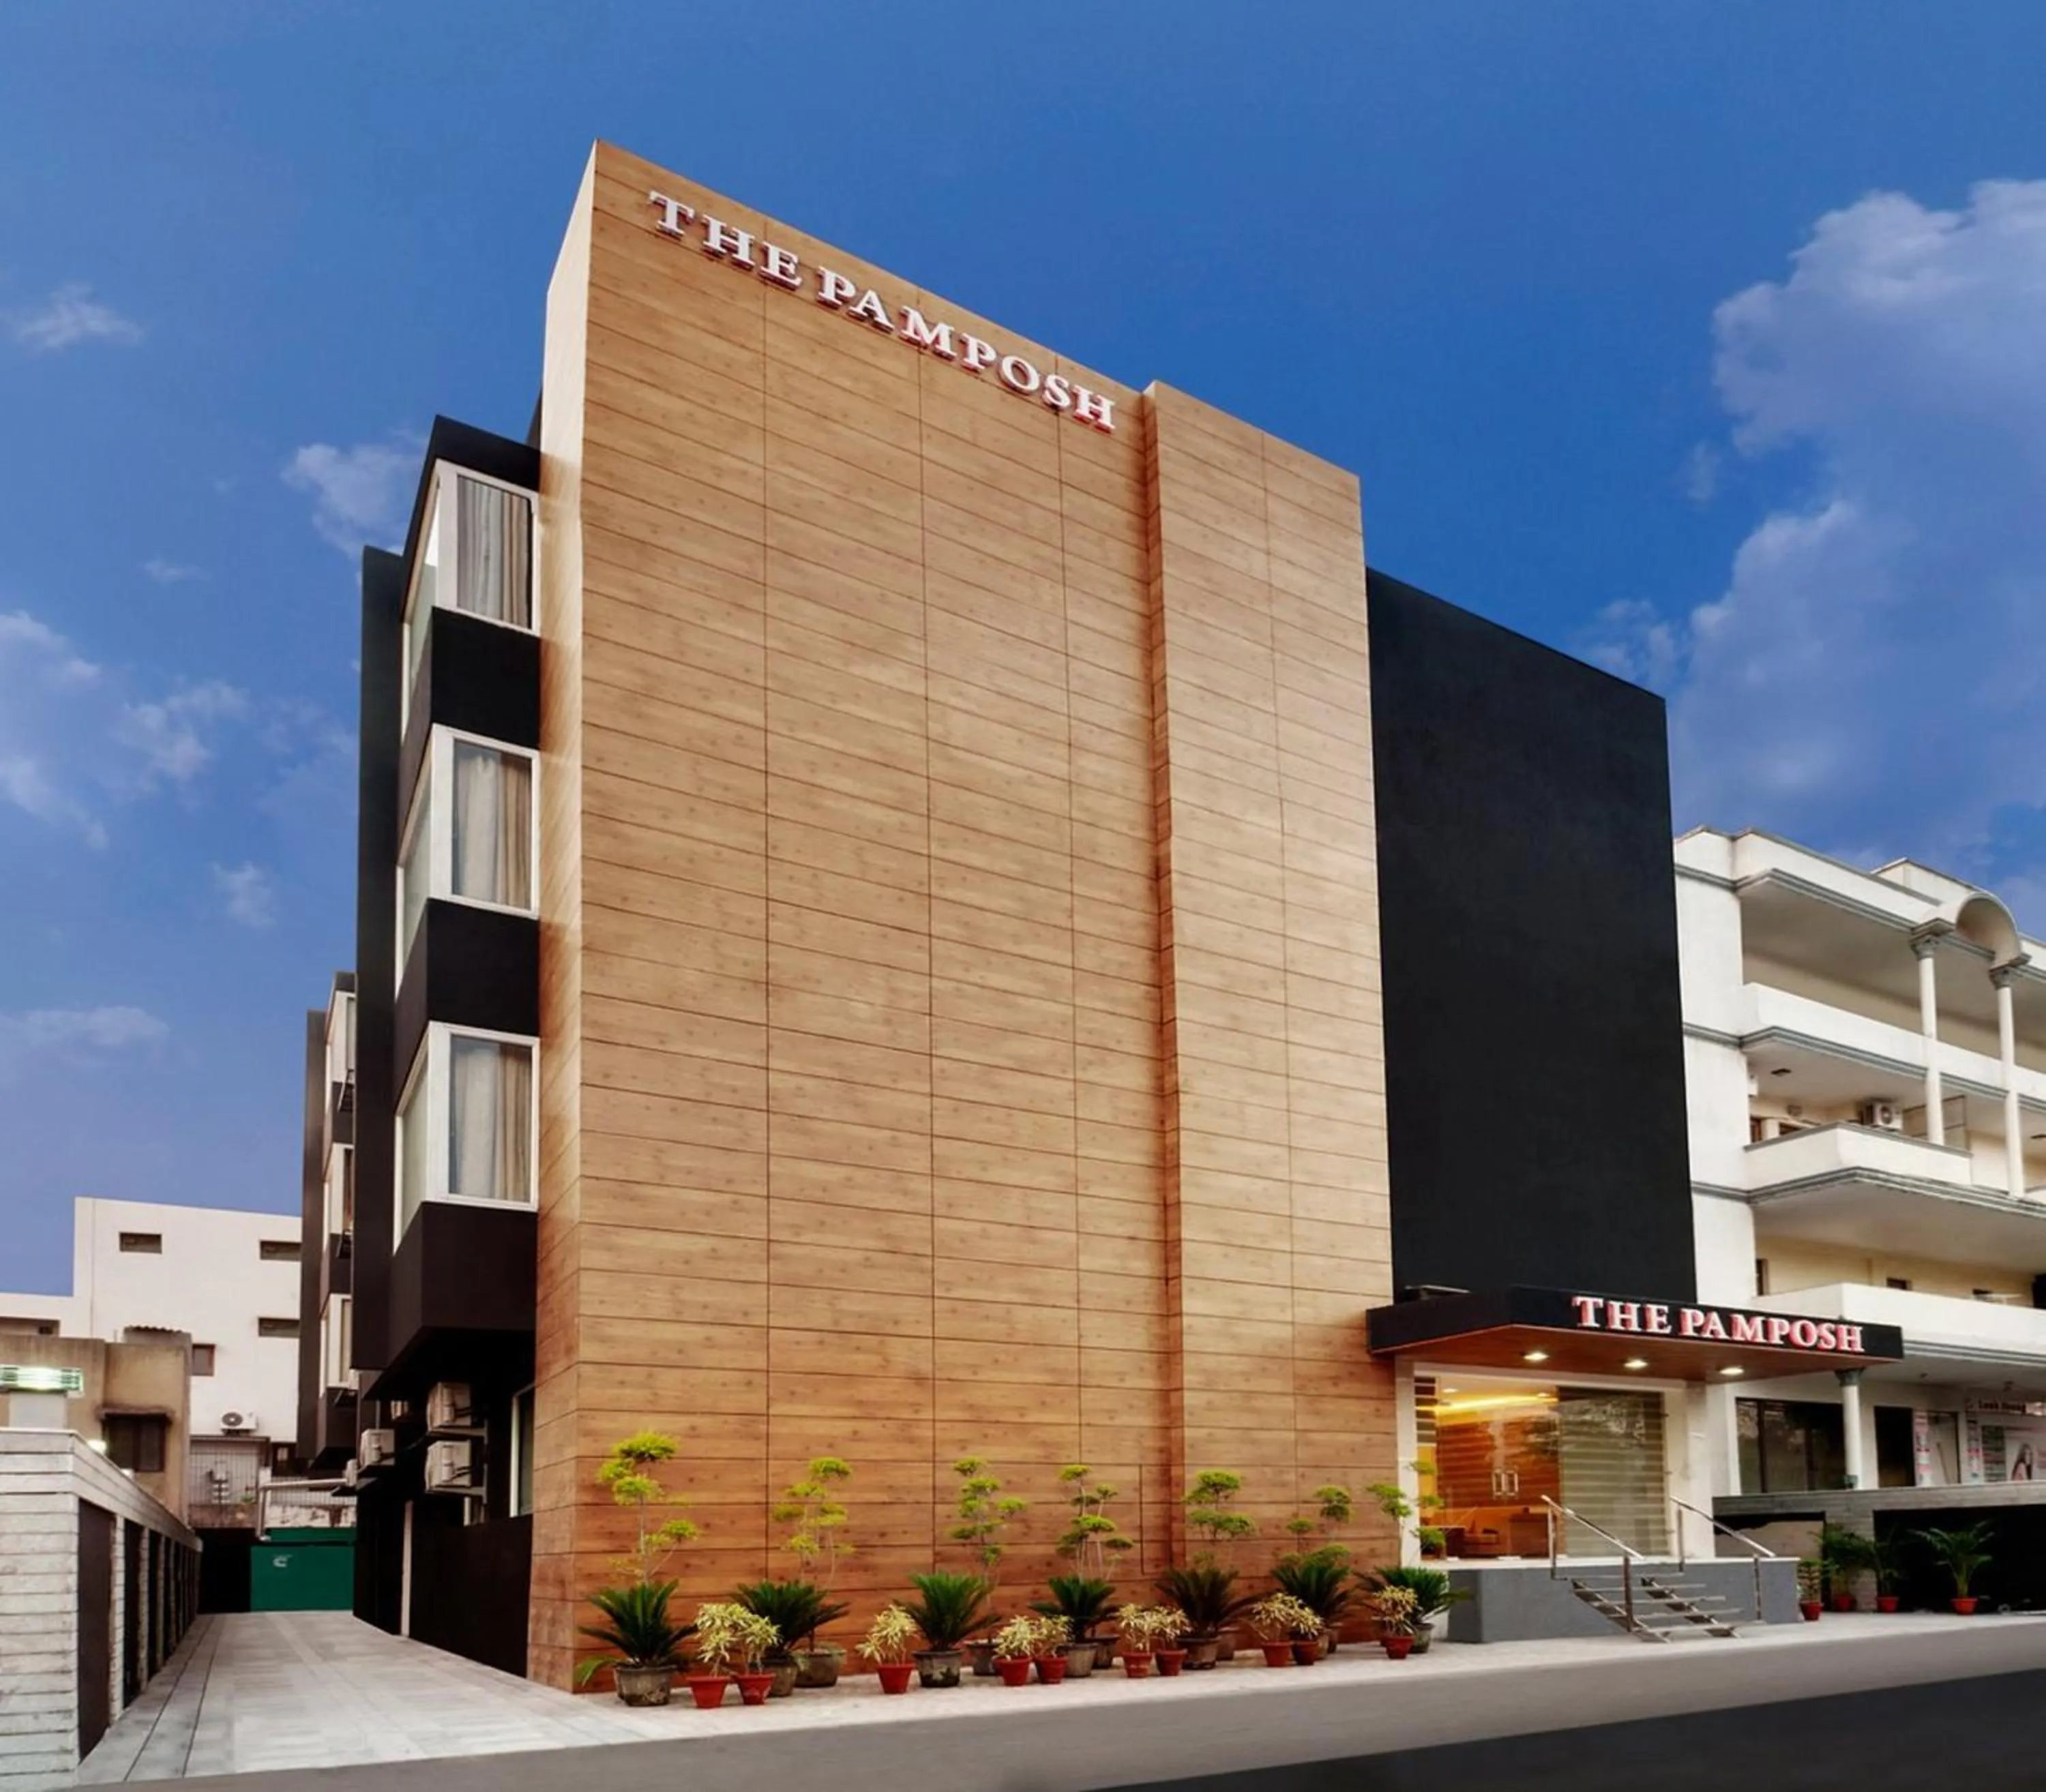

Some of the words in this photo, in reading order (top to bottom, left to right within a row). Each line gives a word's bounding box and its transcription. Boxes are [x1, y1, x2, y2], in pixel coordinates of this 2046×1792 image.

[649, 190, 803, 289] THE
[818, 265, 1116, 433] PAMPOSH
[1572, 1295, 1672, 1334] THE
[1679, 1307, 1865, 1354] PAMPOSH
